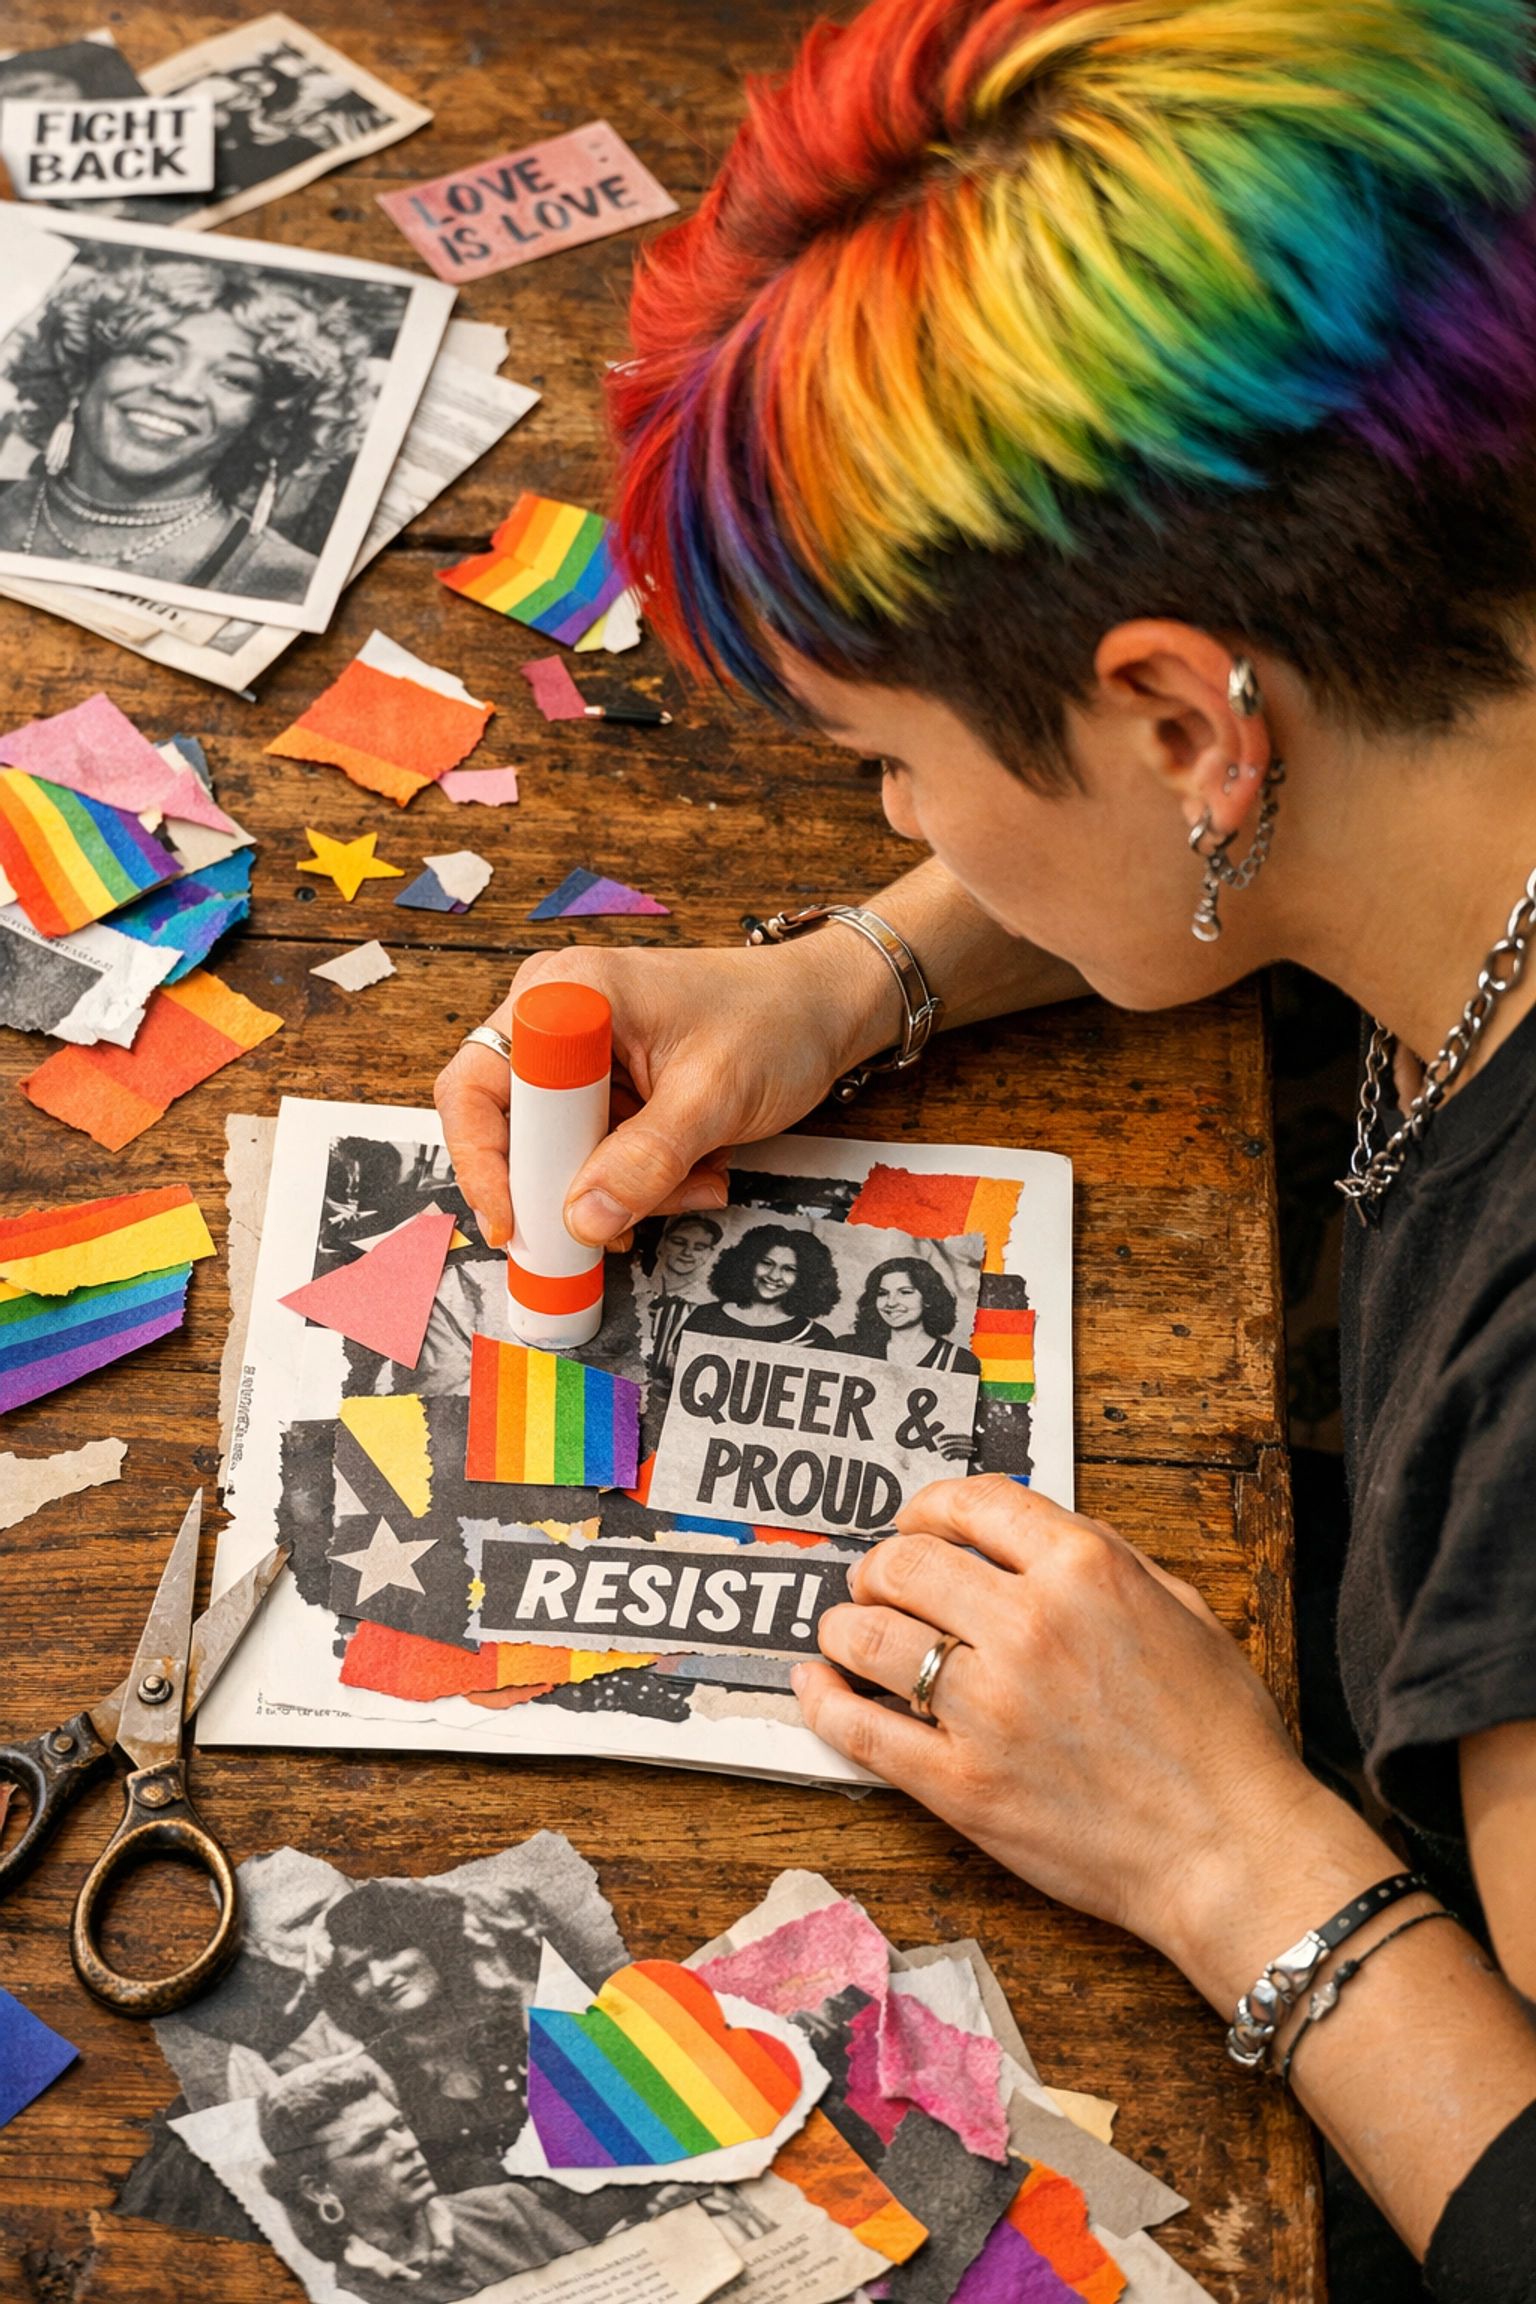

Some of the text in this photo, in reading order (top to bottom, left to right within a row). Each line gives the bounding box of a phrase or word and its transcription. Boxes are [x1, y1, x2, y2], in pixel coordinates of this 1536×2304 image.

[28, 145, 188, 185] BACK
[35, 105, 195, 145] FIGHT
[409, 157, 556, 229] LOVE
[438, 175, 638, 266] IS LOVE
[679, 1353, 946, 1453] QUEER &
[696, 1437, 903, 1530] PROUD
[515, 1558, 823, 1639] RESIST!
